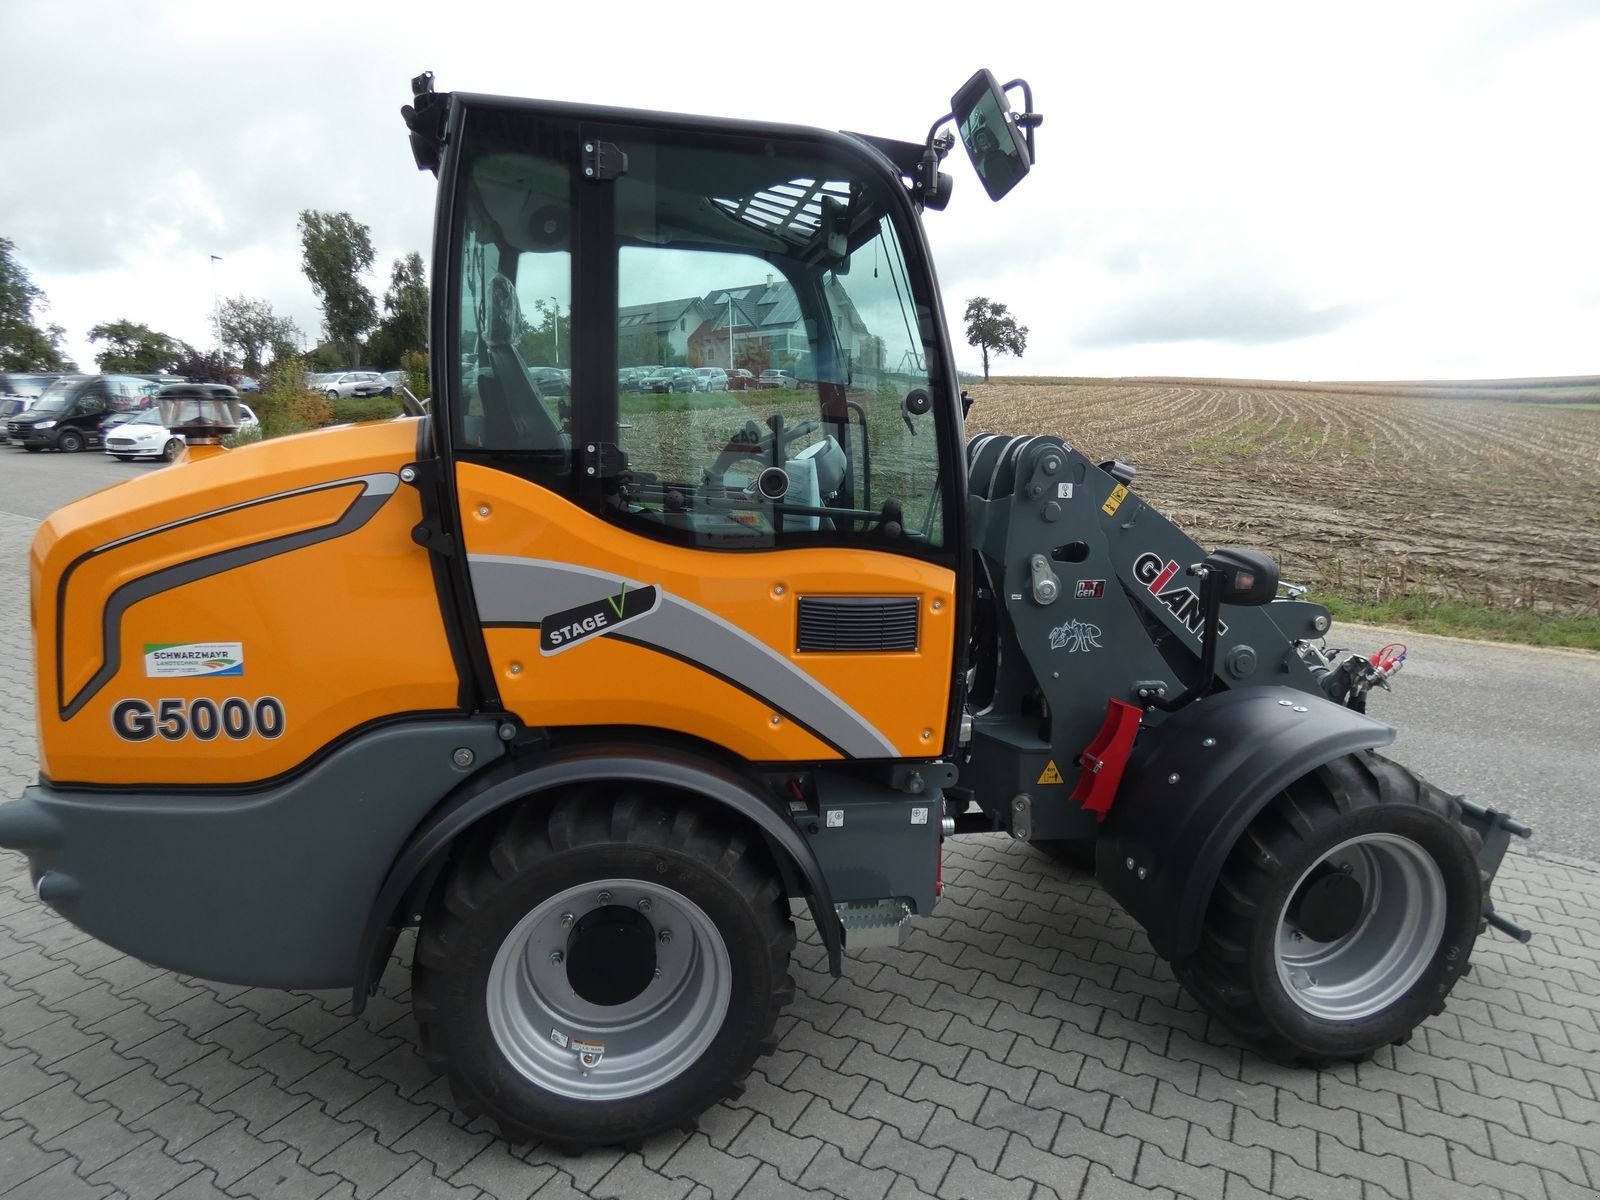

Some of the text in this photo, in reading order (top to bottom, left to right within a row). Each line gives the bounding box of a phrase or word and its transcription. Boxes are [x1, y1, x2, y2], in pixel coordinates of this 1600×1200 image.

[550, 582, 627, 644] STAGE V
[154, 651, 229, 660] SCHWARZMAYR
[111, 696, 286, 742] G5000
